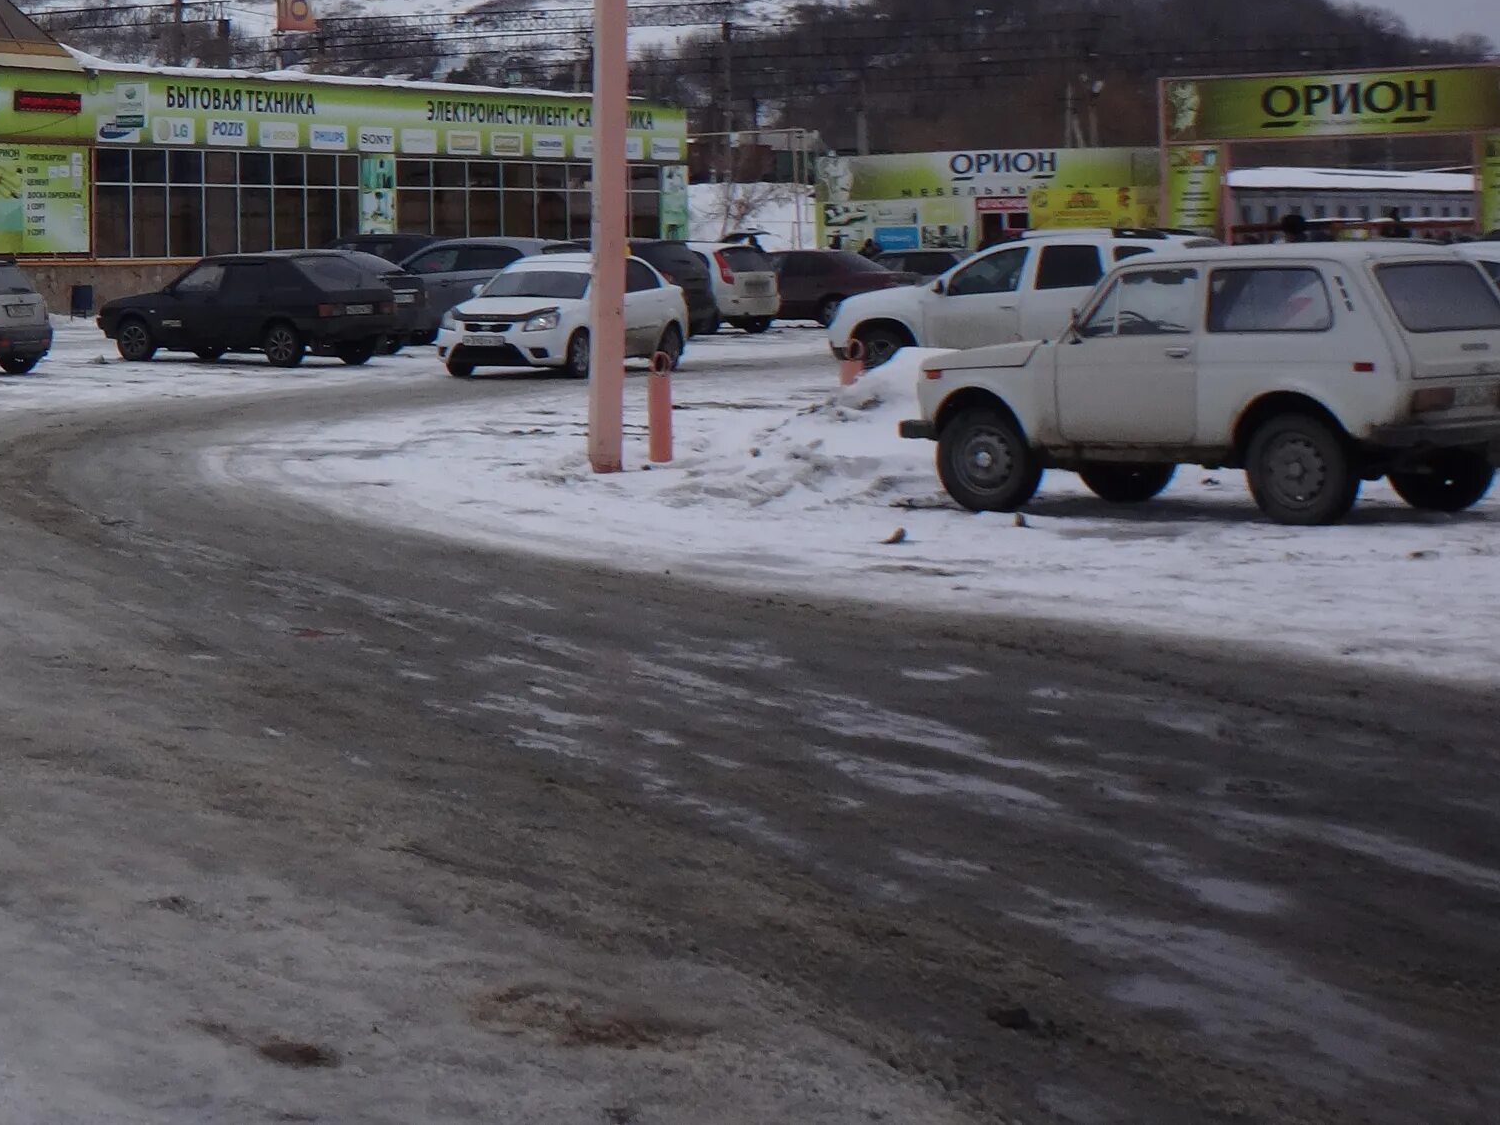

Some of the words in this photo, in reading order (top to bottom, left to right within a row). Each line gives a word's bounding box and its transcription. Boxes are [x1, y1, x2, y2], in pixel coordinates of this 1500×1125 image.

[166, 86, 244, 111] БЫТОВАЯ
[246, 90, 316, 115] ТЕХНИКА
[1261, 79, 1437, 117] ОРИОН
[173, 123, 189, 137] LG
[211, 121, 244, 137] POZIS
[361, 134, 392, 145] SONY
[950, 152, 1057, 174] ОРИОН
[901, 183, 1048, 198] МЕБЕЛЬНЫ
